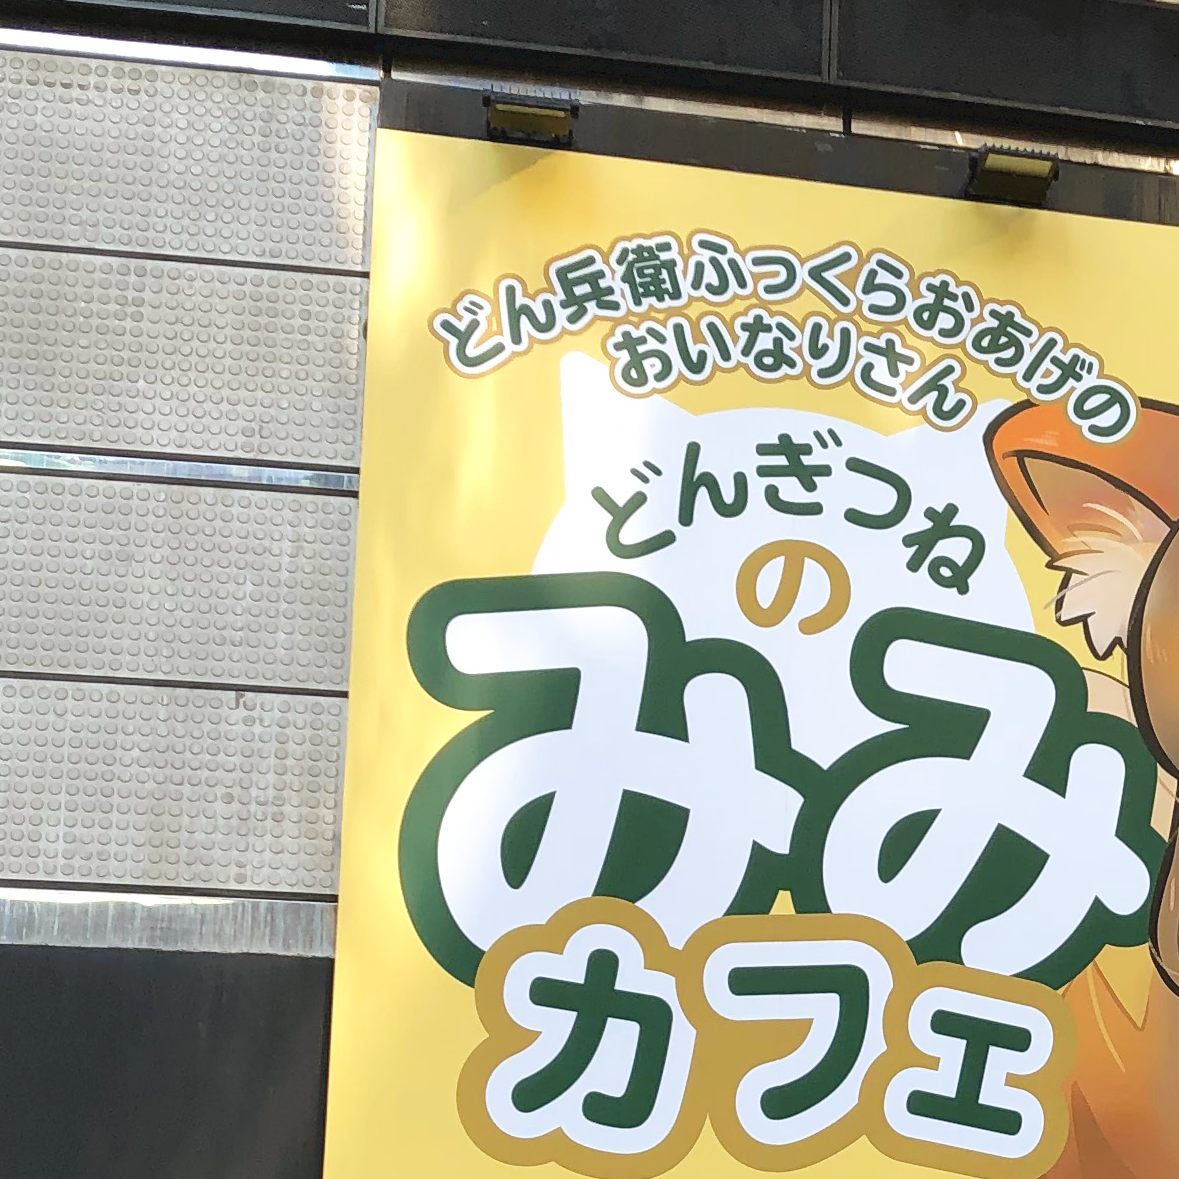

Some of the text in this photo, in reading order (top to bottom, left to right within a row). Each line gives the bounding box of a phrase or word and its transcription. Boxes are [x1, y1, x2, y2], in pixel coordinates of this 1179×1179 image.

[434, 232, 1136, 441] どん兵衛ふっくらおあげの
[606, 305, 974, 426] おいなりさん
[590, 427, 988, 596] どんぎつね
[735, 538, 852, 636] の
[408, 580, 1162, 982] みみ
[486, 923, 1054, 1159] カフェ
